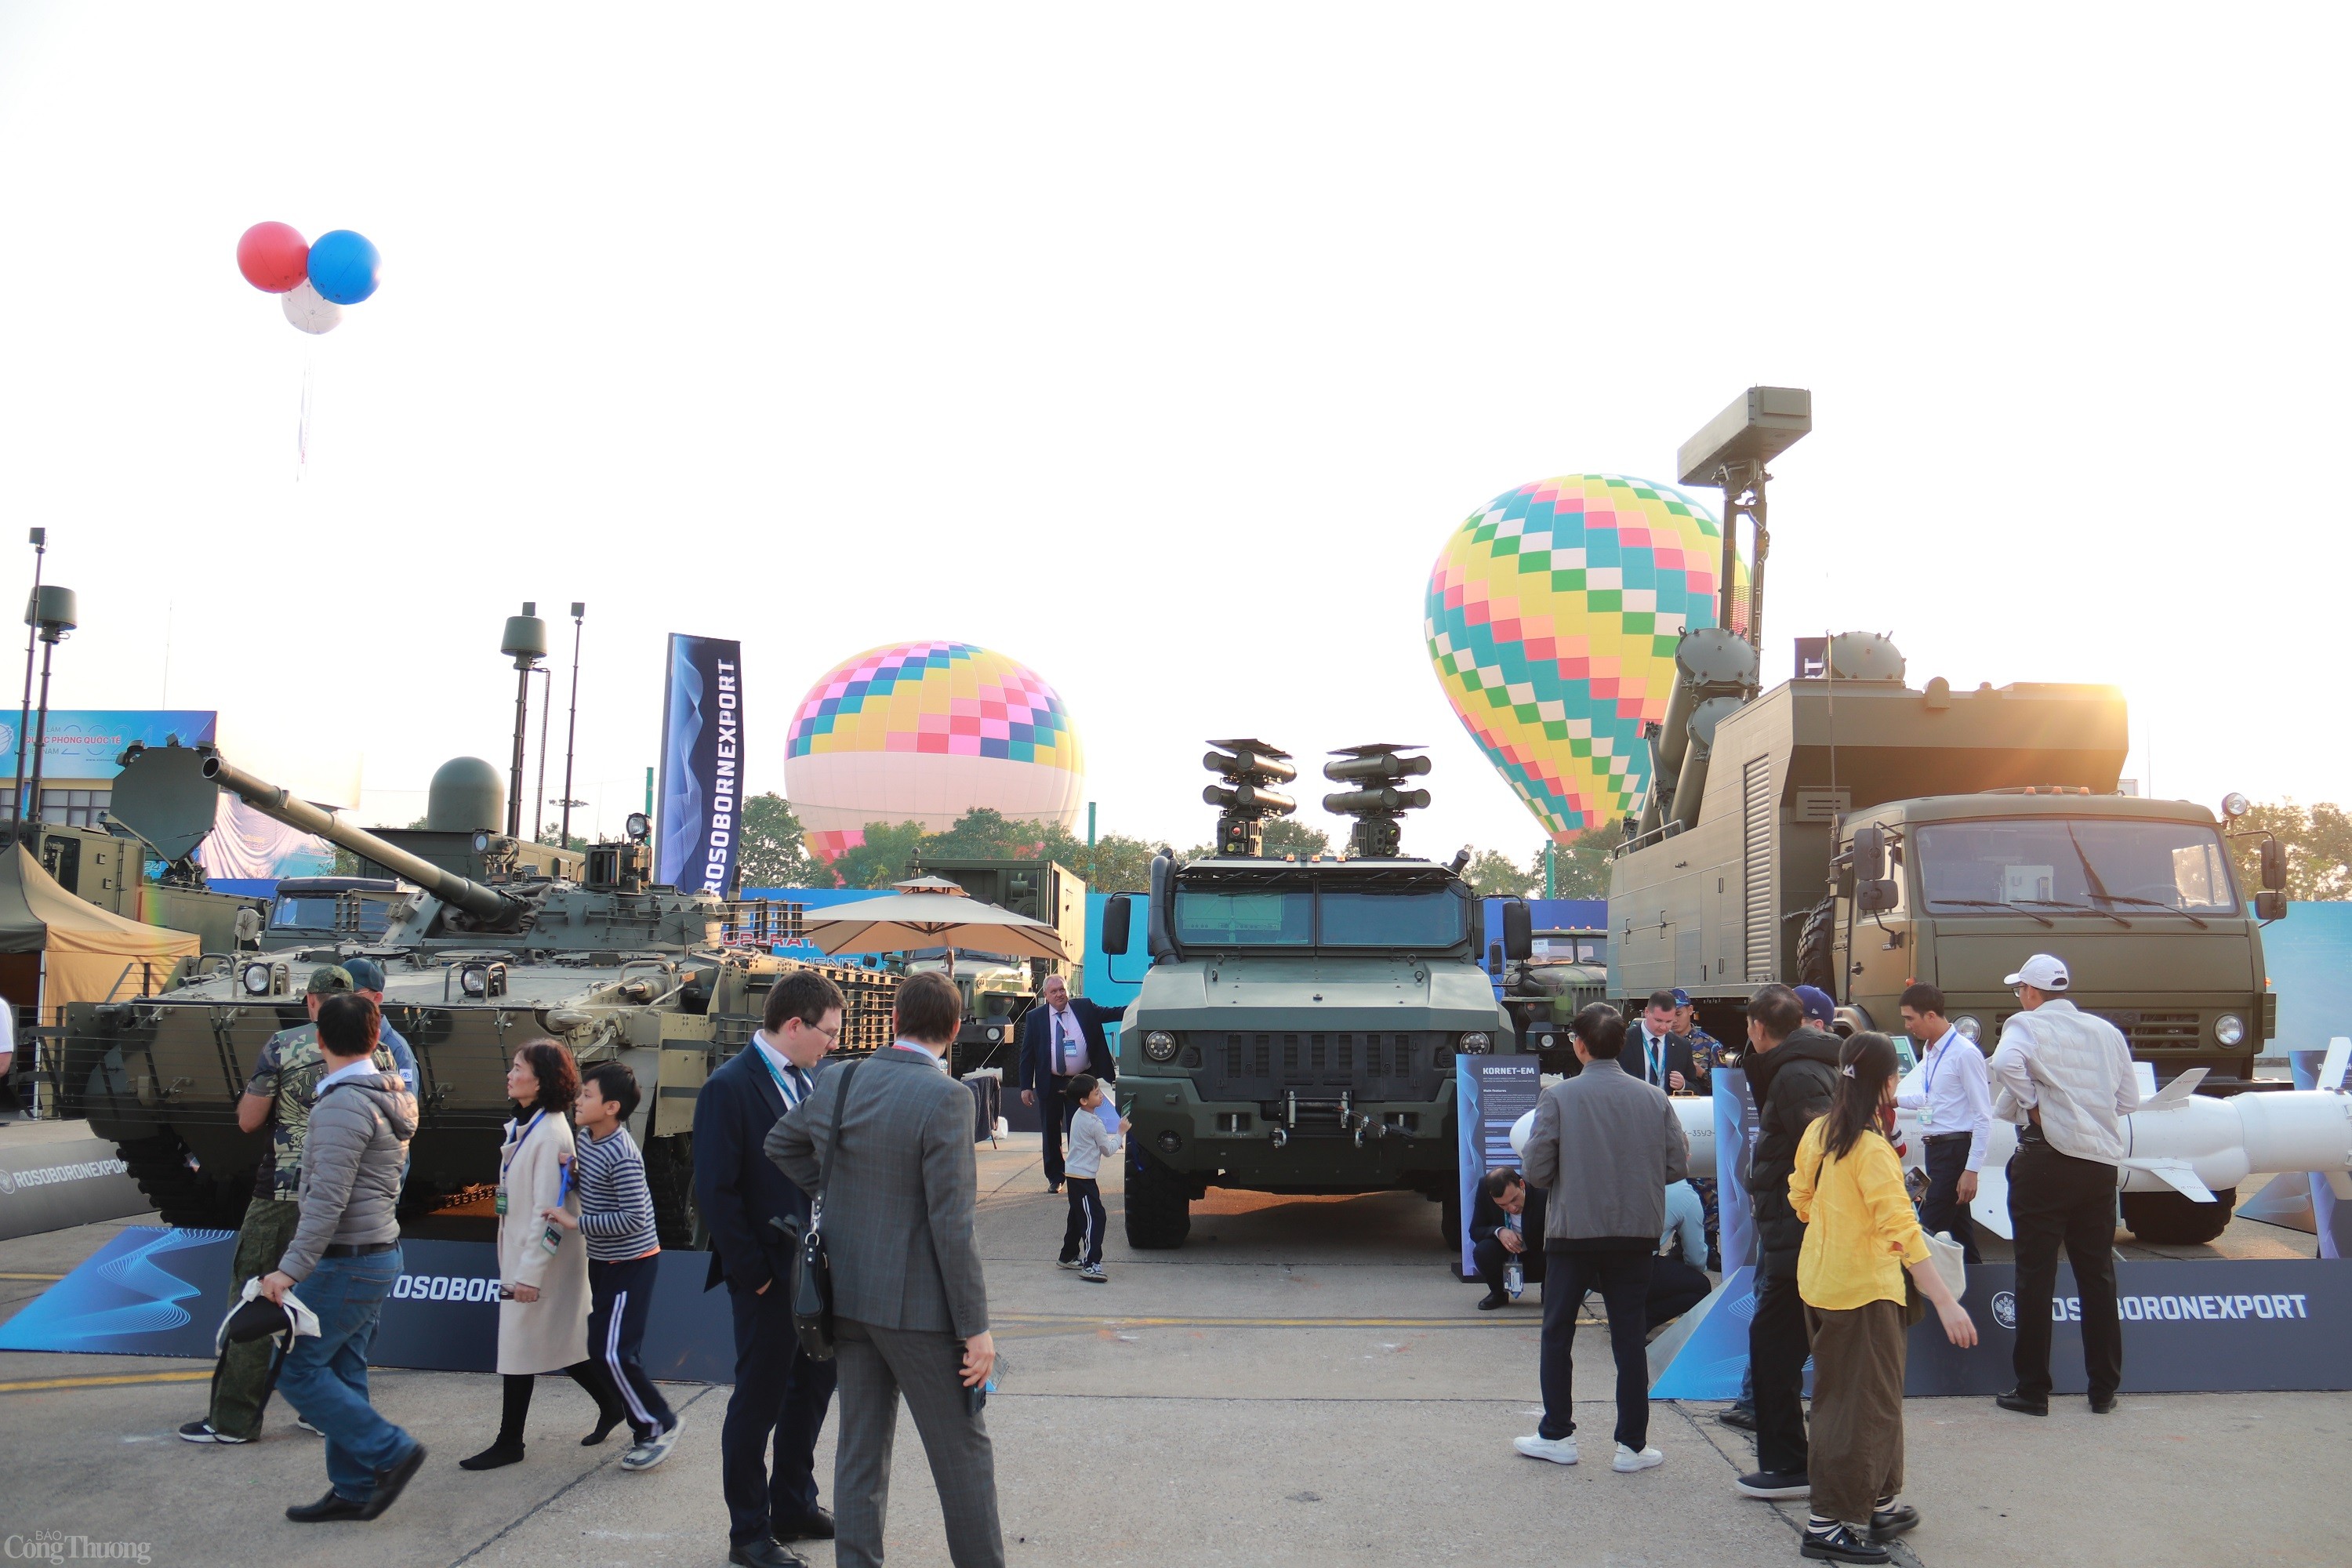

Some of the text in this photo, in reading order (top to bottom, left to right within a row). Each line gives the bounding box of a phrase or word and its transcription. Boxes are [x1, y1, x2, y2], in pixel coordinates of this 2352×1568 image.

[52, 735, 82, 744] PHÒNG
[13, 1158, 129, 1189] ROSOBORONEXPOR
[387, 1275, 500, 1302] OSOBOR
[2053, 1294, 2307, 1321] OSORONEXPORT
